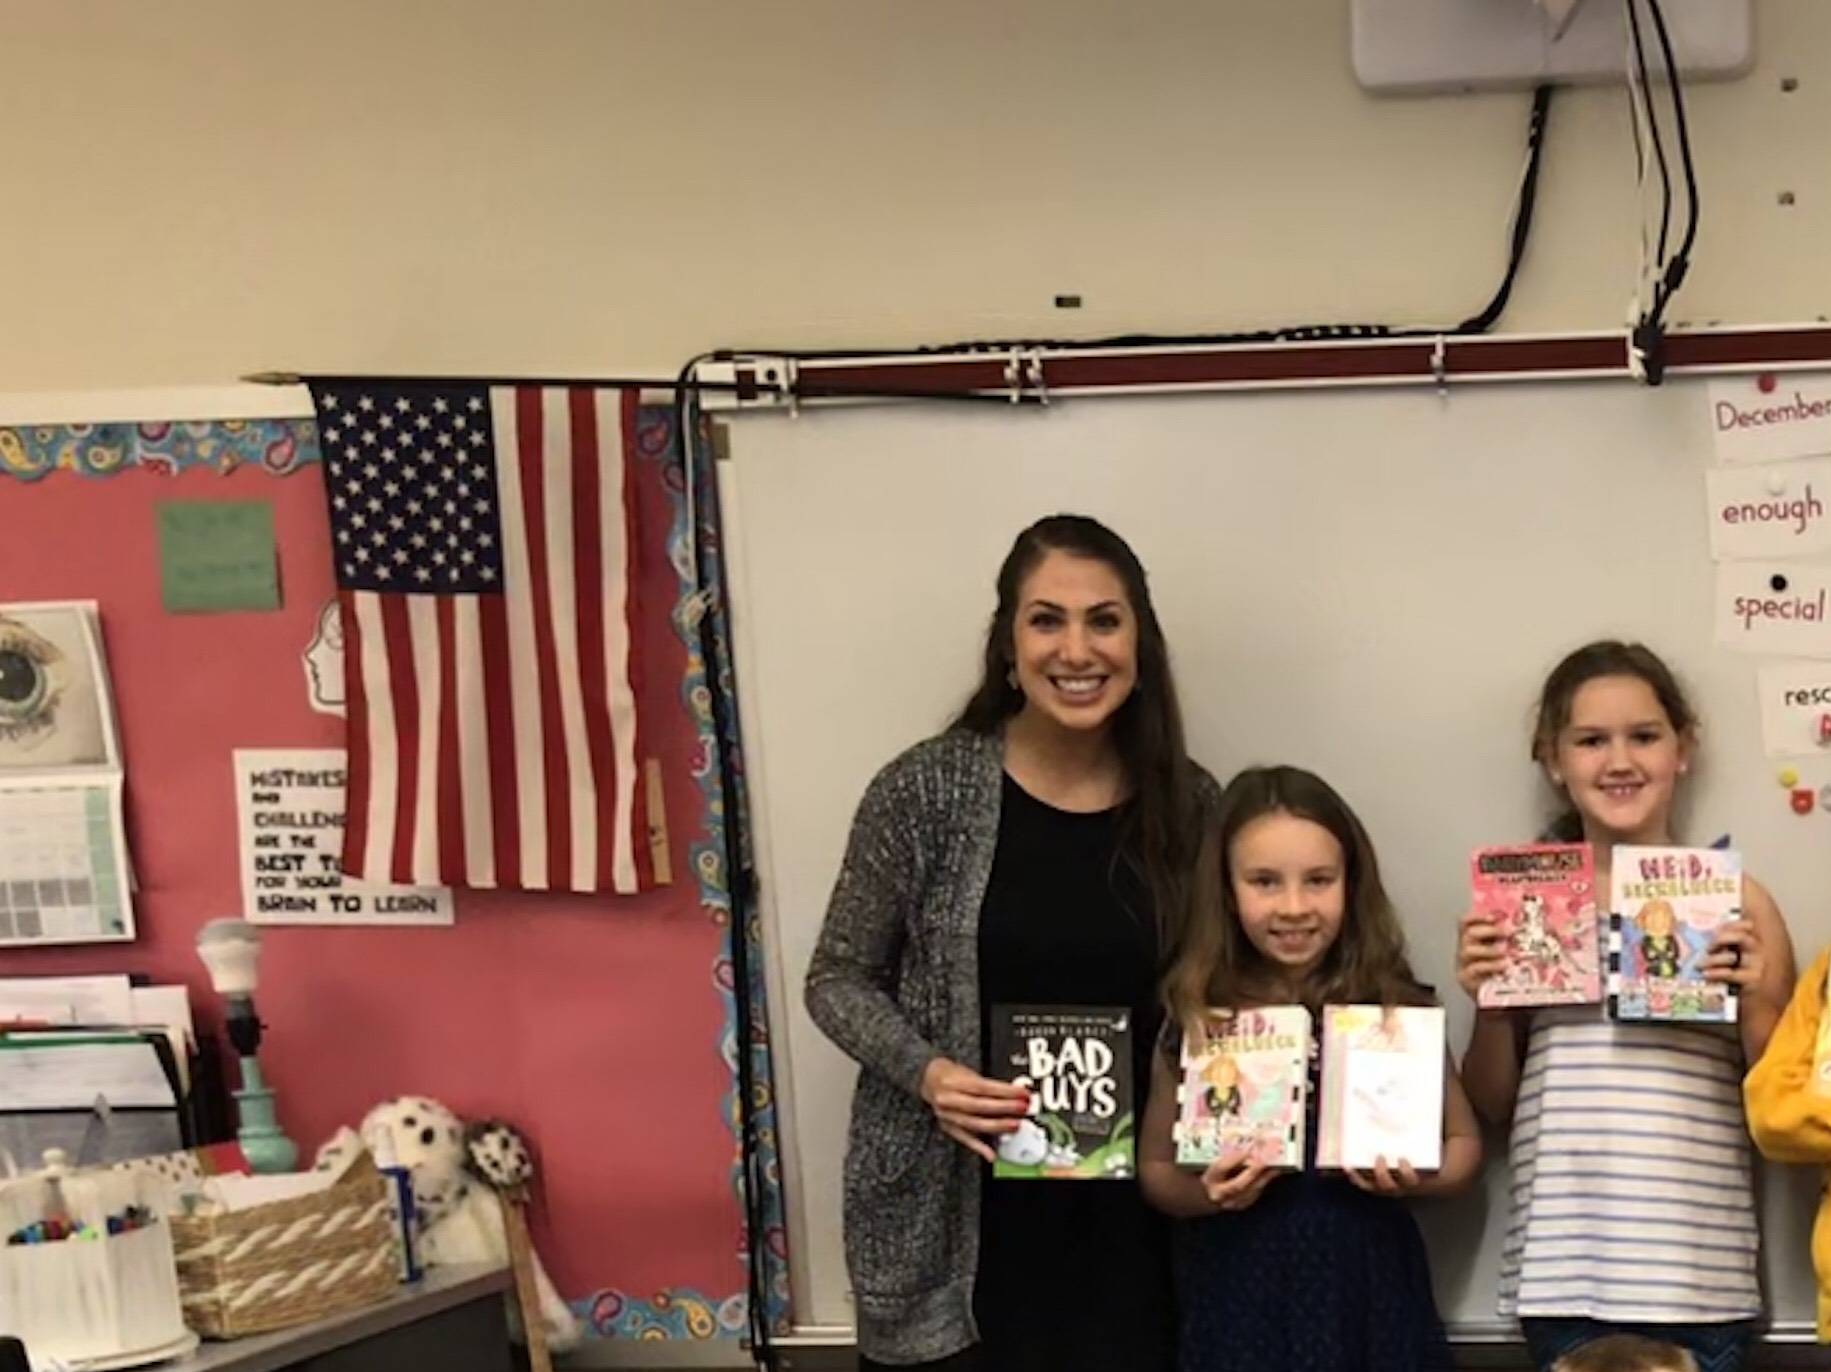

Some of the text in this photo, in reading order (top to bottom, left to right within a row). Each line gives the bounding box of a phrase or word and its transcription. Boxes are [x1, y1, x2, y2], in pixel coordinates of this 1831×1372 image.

[1722, 484, 1823, 536] enough
[1733, 589, 1826, 631] special
[254, 854, 306, 872] BEST
[329, 895, 362, 913] TO
[1027, 1036, 1115, 1079] BAD
